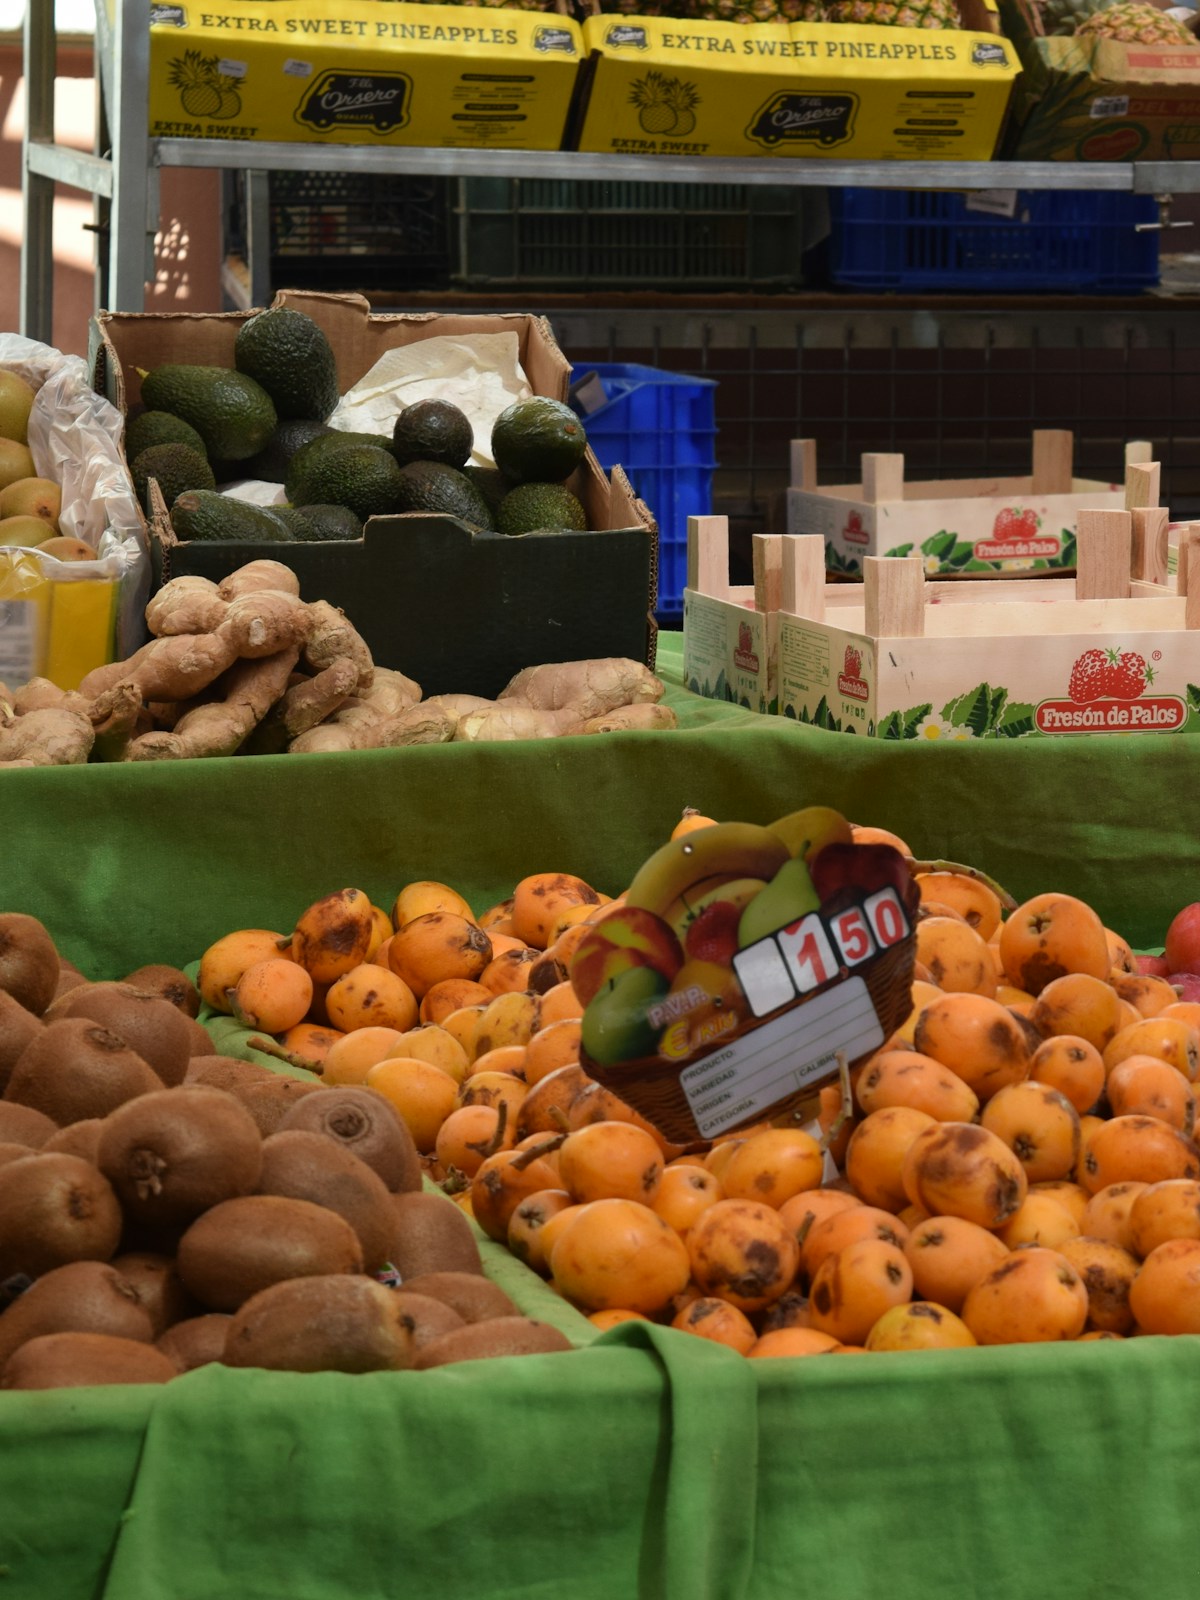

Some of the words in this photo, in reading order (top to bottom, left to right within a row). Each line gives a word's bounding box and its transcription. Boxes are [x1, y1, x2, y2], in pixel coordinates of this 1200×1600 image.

[200, 14, 279, 32] EXTRA
[285, 19, 367, 36] SWEET
[375, 22, 518, 45] PINEAPPLES
[661, 33, 736, 53] EXTRA
[743, 40, 818, 57] SWEET
[825, 41, 957, 60] PINEAPPLES
[1162, 56, 1190, 66] DEL
[320, 88, 400, 110] Orsero
[1130, 101, 1168, 114] DEL
[771, 106, 847, 127] Orsero
[154, 120, 203, 133] EXTRA
[206, 124, 258, 137] SWEET
[611, 138, 657, 150] EXTRA
[660, 141, 710, 153] SWEET
[977, 541, 1015, 557] Fresón
[1028, 541, 1057, 554] Palos
[1042, 707, 1105, 727] Fresón
[1107, 705, 1129, 725] de
[1130, 704, 1178, 724] Palos
